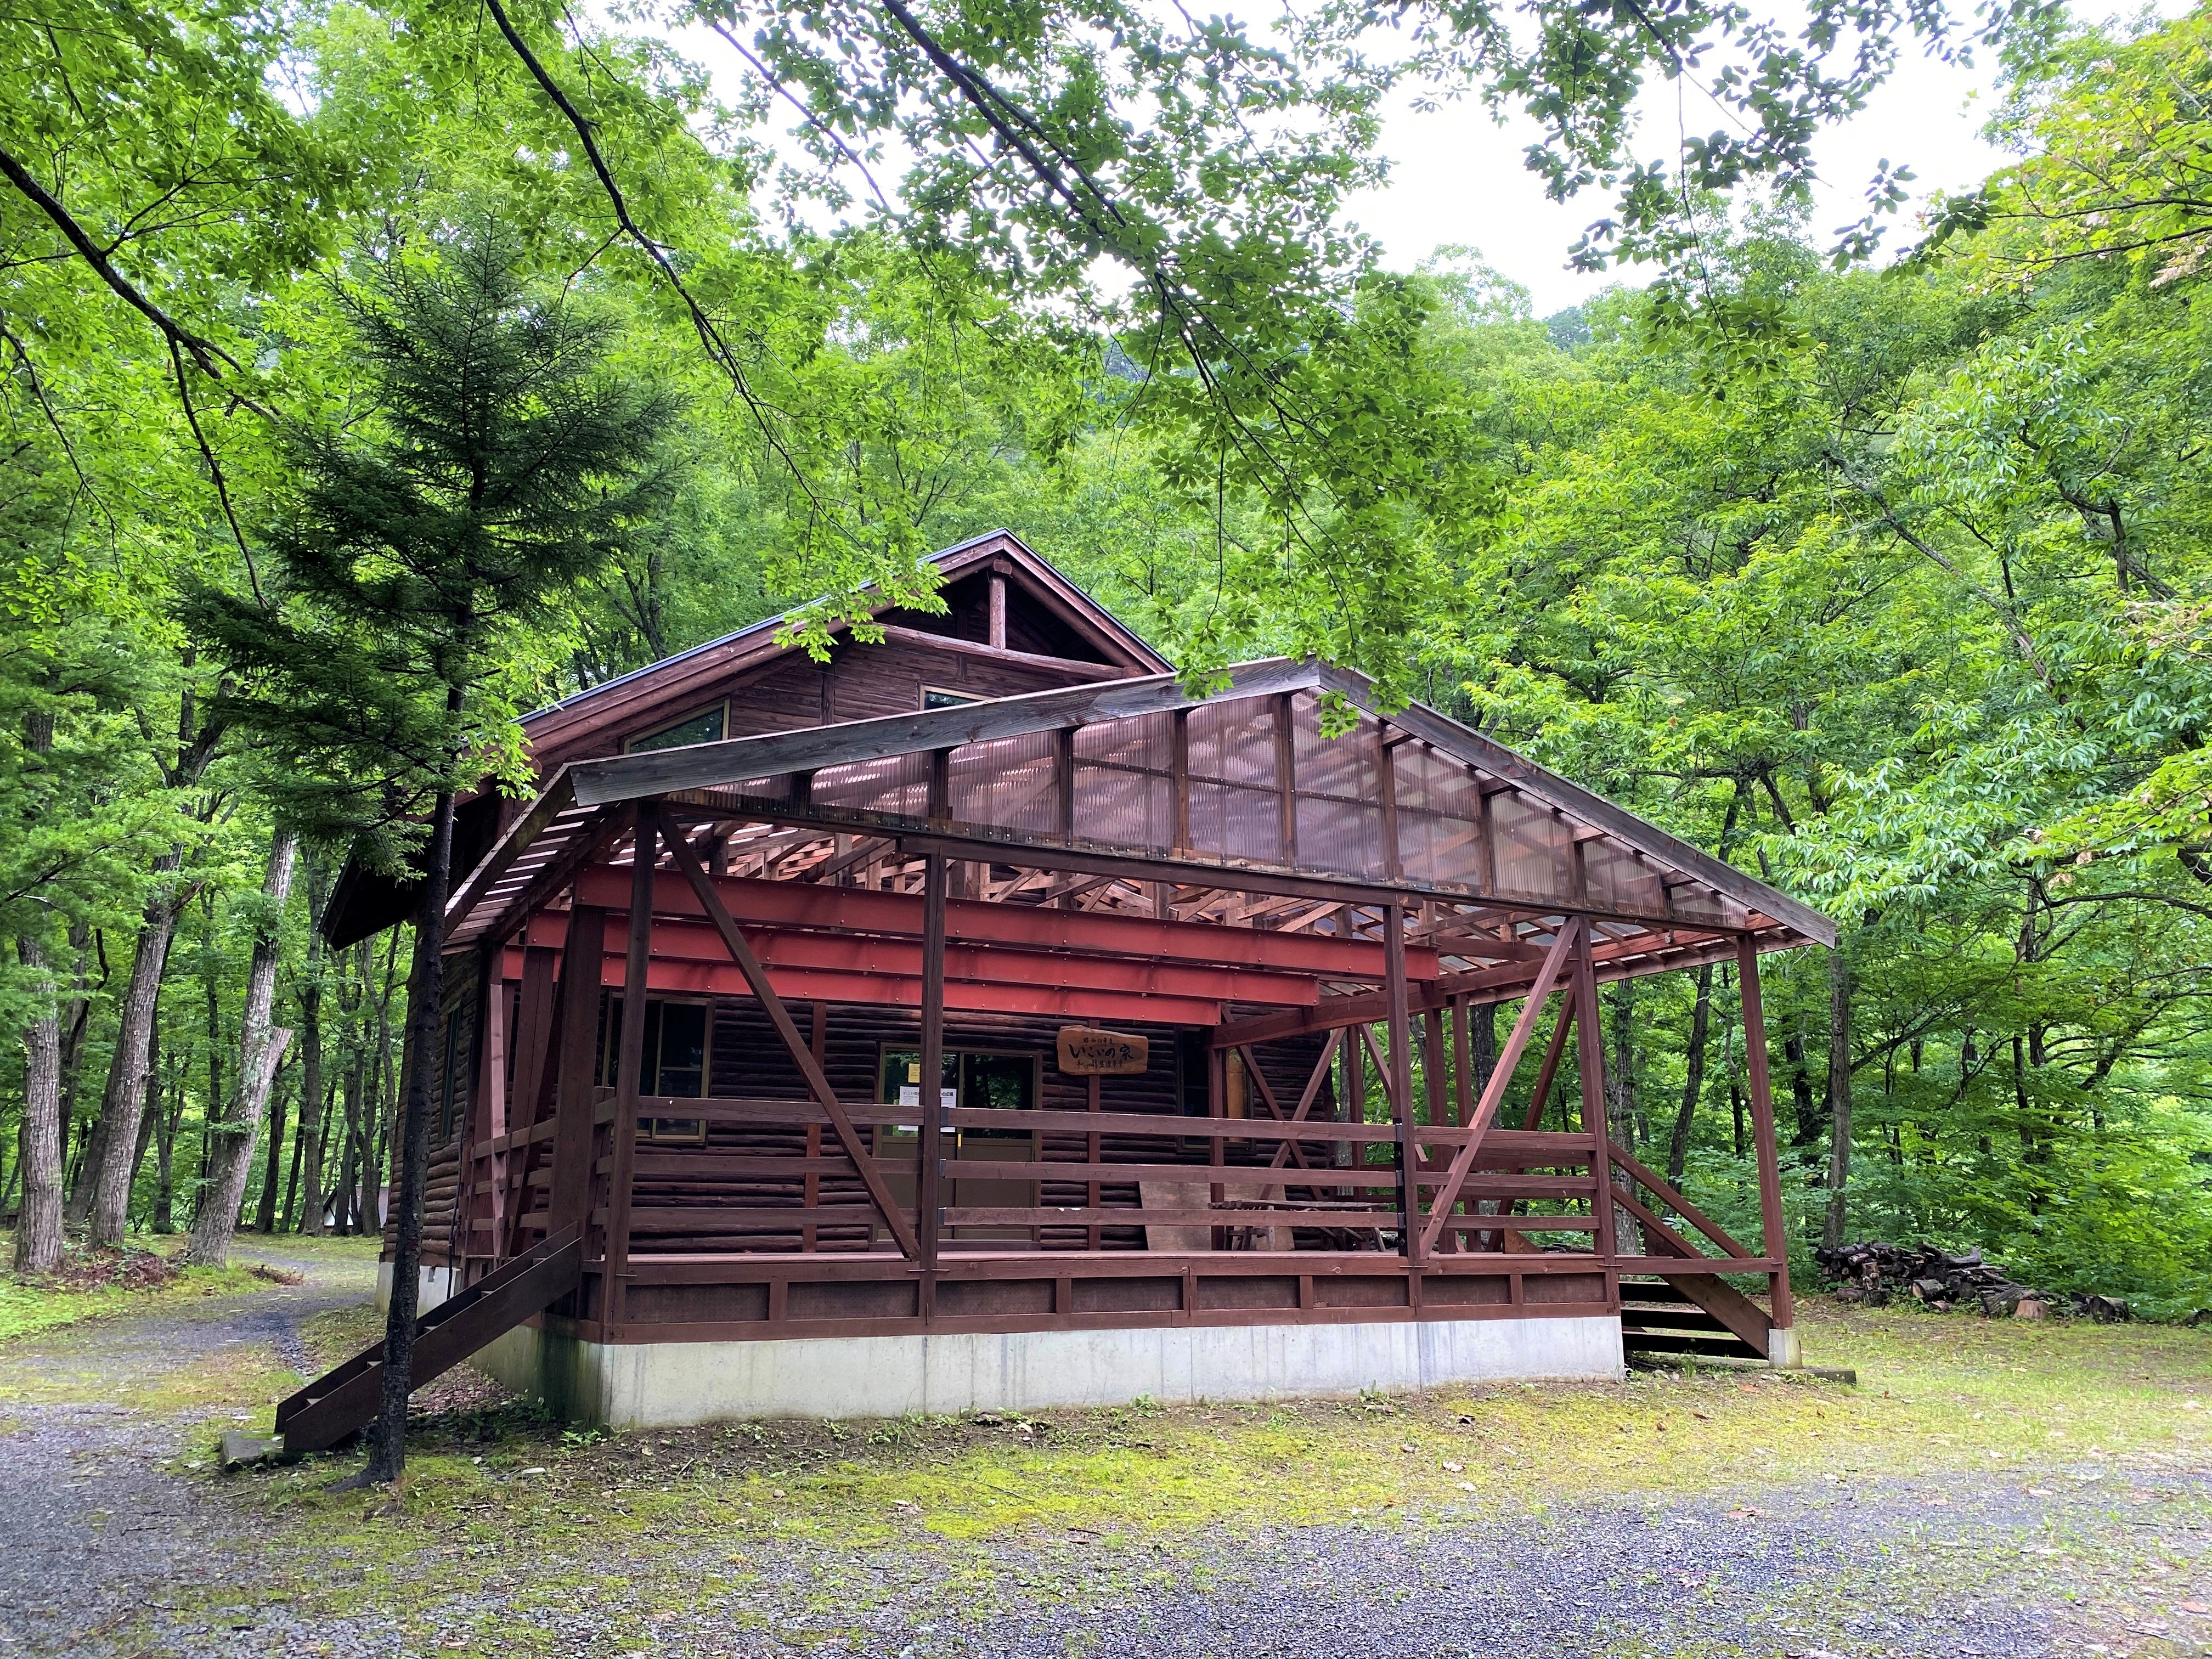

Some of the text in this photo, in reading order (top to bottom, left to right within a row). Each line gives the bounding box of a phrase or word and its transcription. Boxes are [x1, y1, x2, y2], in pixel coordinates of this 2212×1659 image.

[1068, 1043, 1134, 1060] いこいの家
